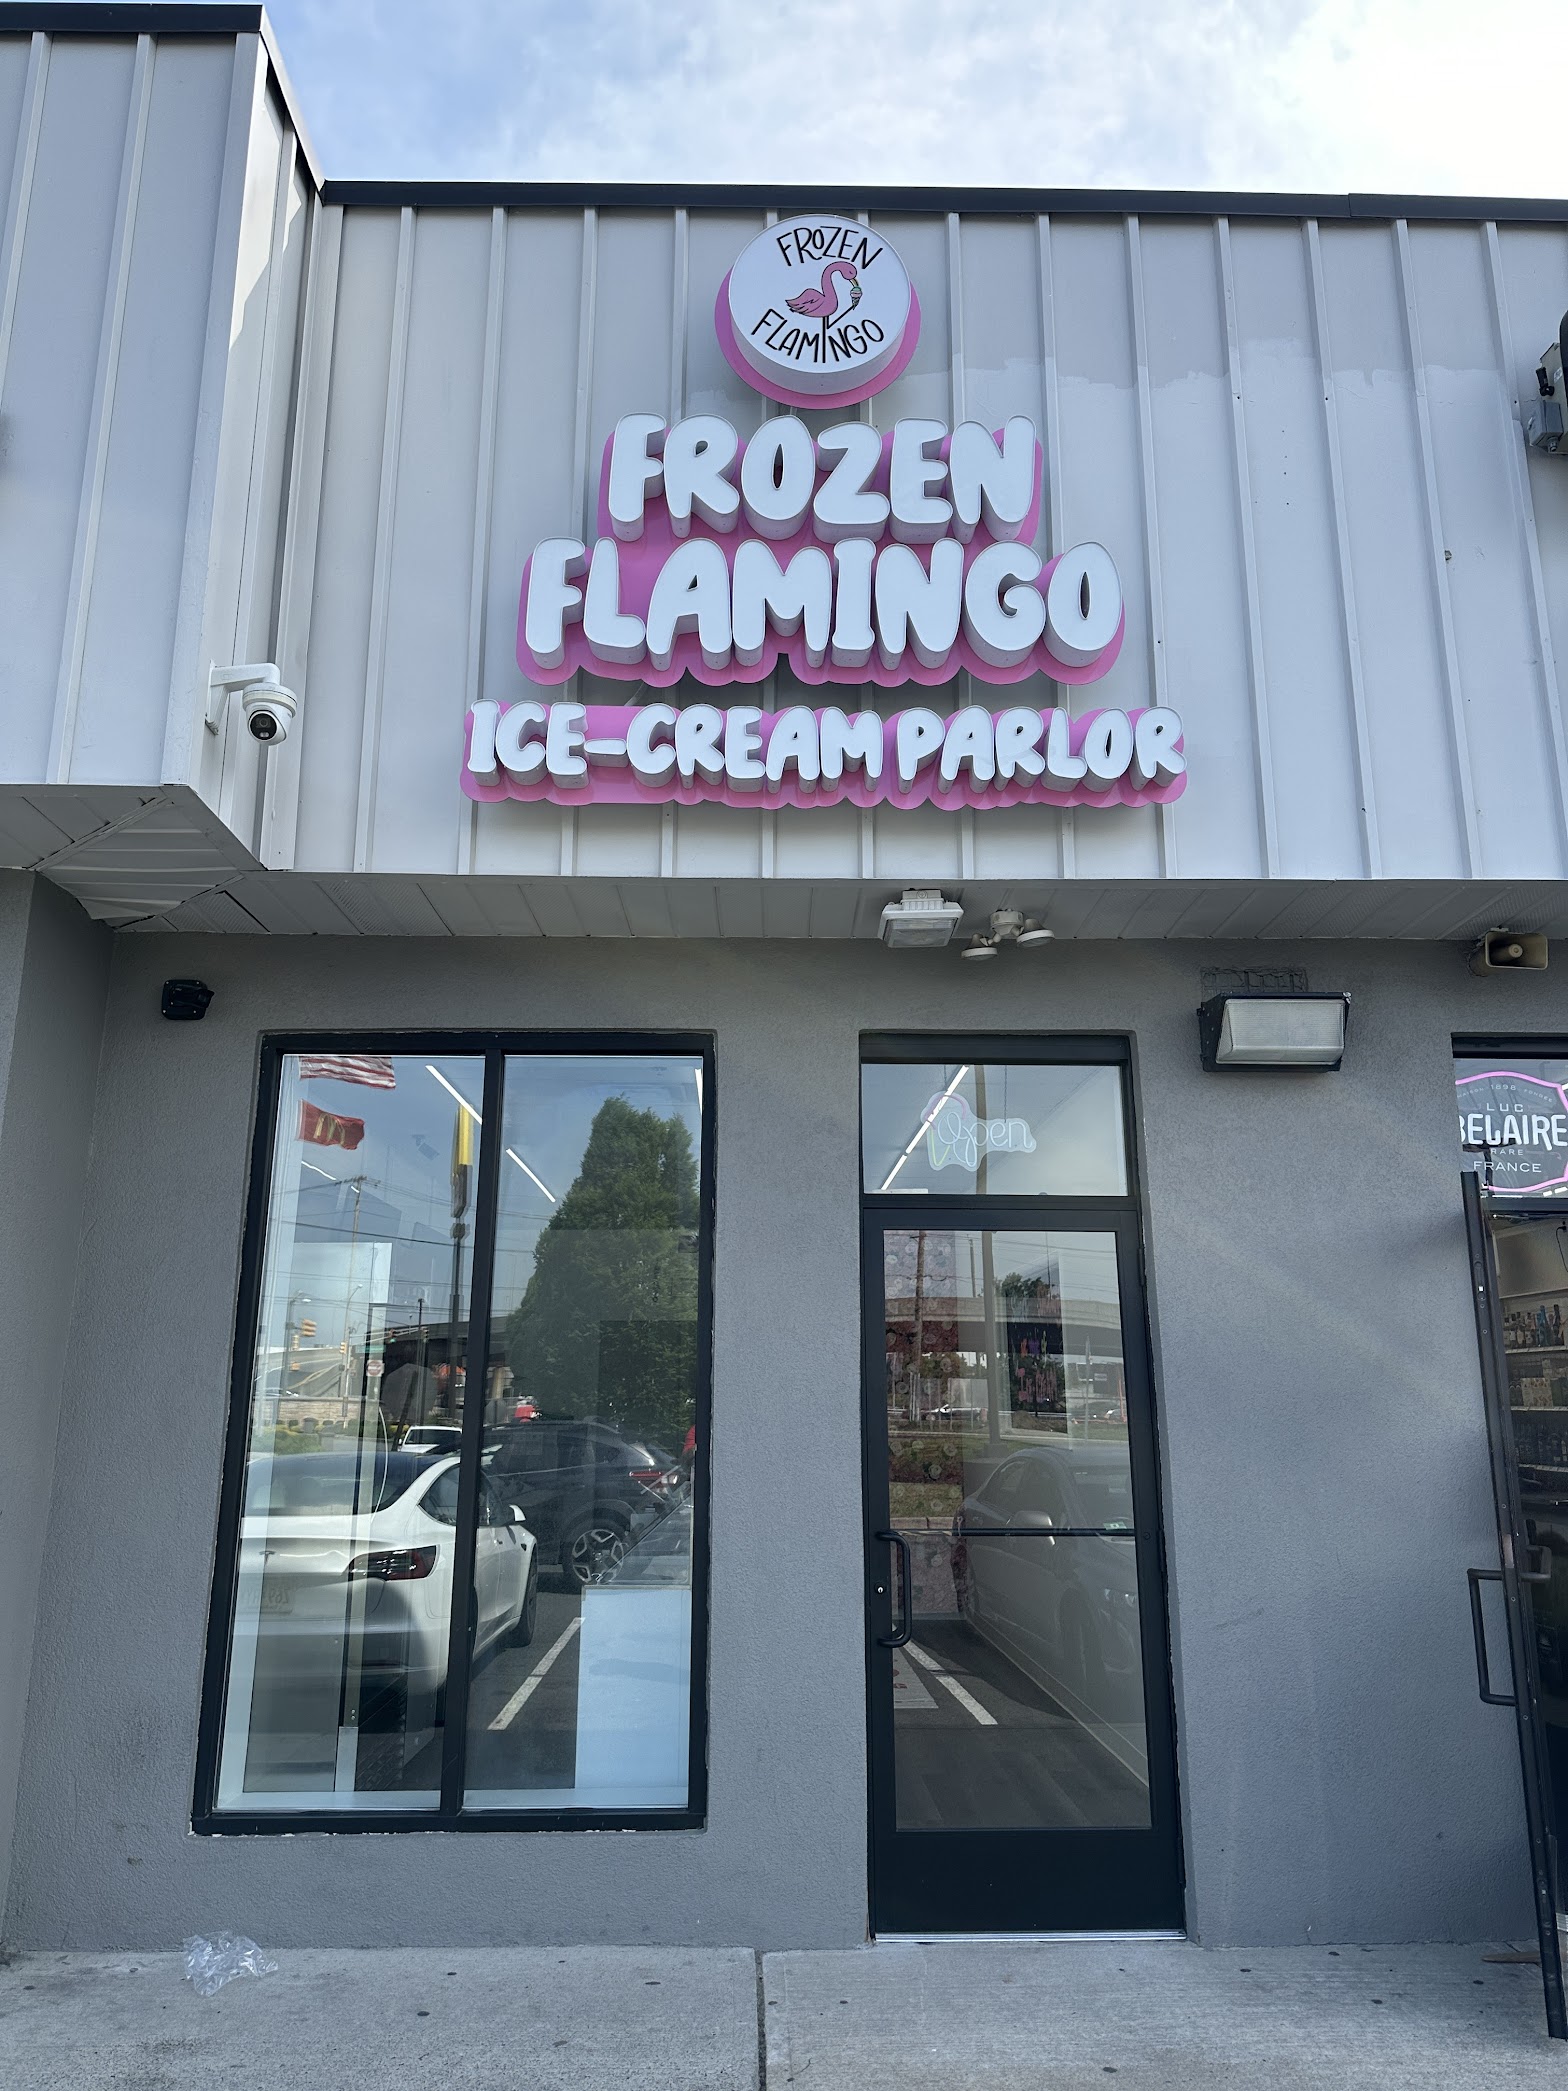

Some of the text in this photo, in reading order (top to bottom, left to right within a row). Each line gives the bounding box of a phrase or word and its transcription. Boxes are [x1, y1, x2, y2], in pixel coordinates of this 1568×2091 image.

[776, 225, 883, 270] FROZEN
[751, 308, 884, 363] FLAMINGO
[608, 412, 1037, 542] FROZEN
[525, 536, 1122, 671] FLAMINGO
[468, 699, 1187, 793] ICE-CREAM PARLOR
[1486, 1102, 1524, 1113] LUC
[937, 1111, 1033, 1168] Open
[1473, 1160, 1542, 1173] FRANCE
[1490, 1147, 1524, 1156] RARE
